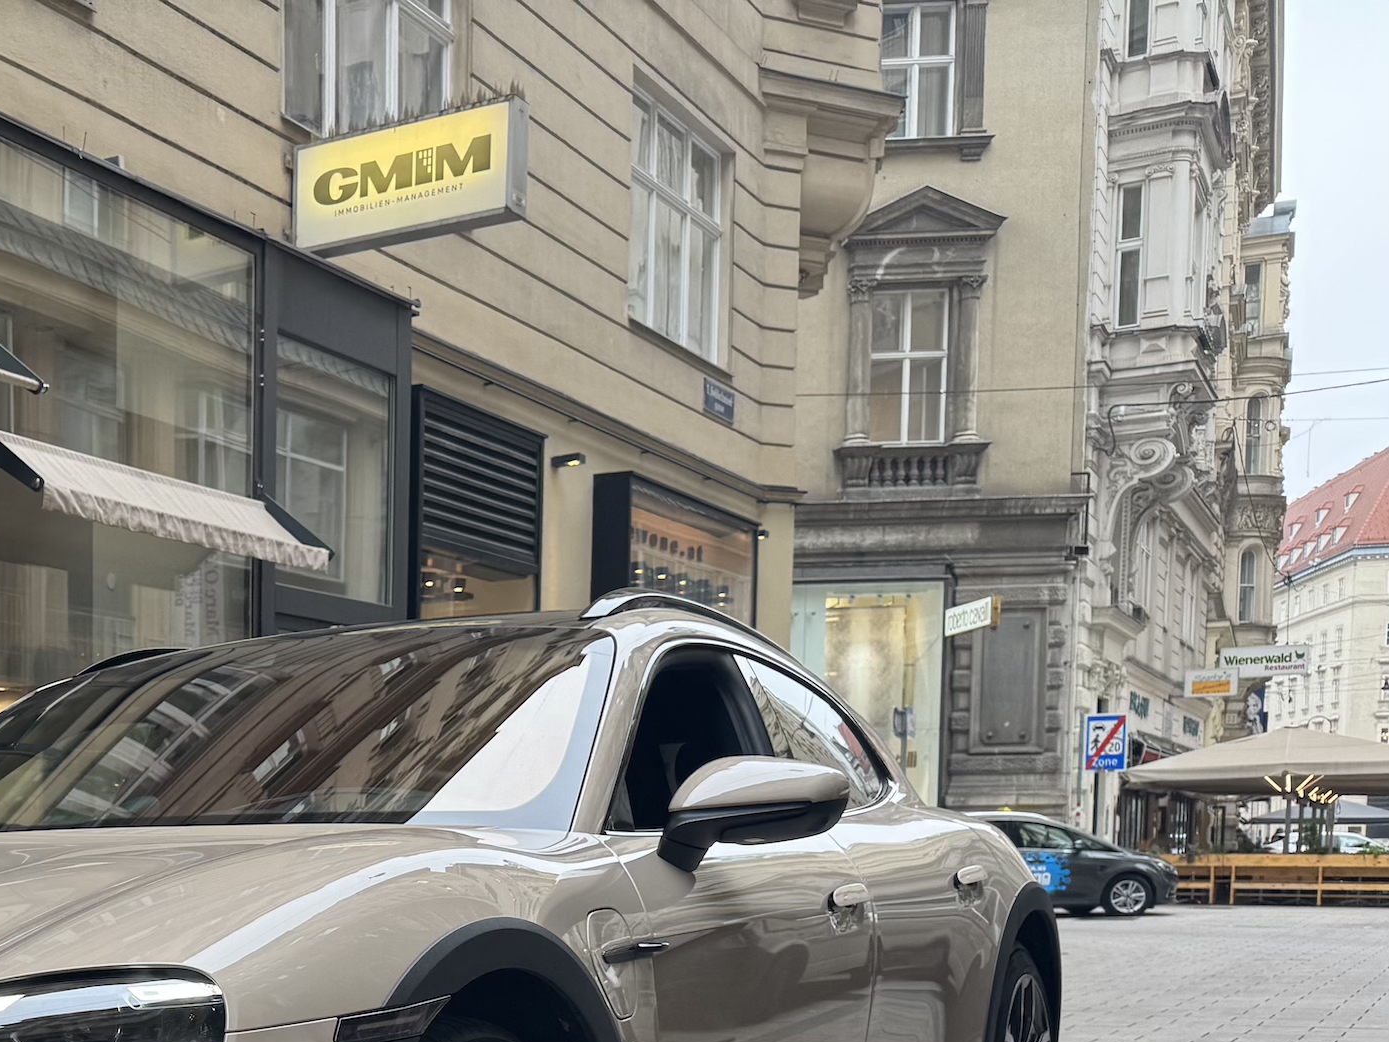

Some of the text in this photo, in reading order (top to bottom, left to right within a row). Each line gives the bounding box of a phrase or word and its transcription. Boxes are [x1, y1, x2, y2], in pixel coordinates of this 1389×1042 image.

[334, 183, 464, 217] IMMOBILIEN-MANAGEMENT
[1224, 652, 1293, 666] Wienerwald
[1264, 663, 1306, 672] Restaurant
[1108, 741, 1121, 753] 20
